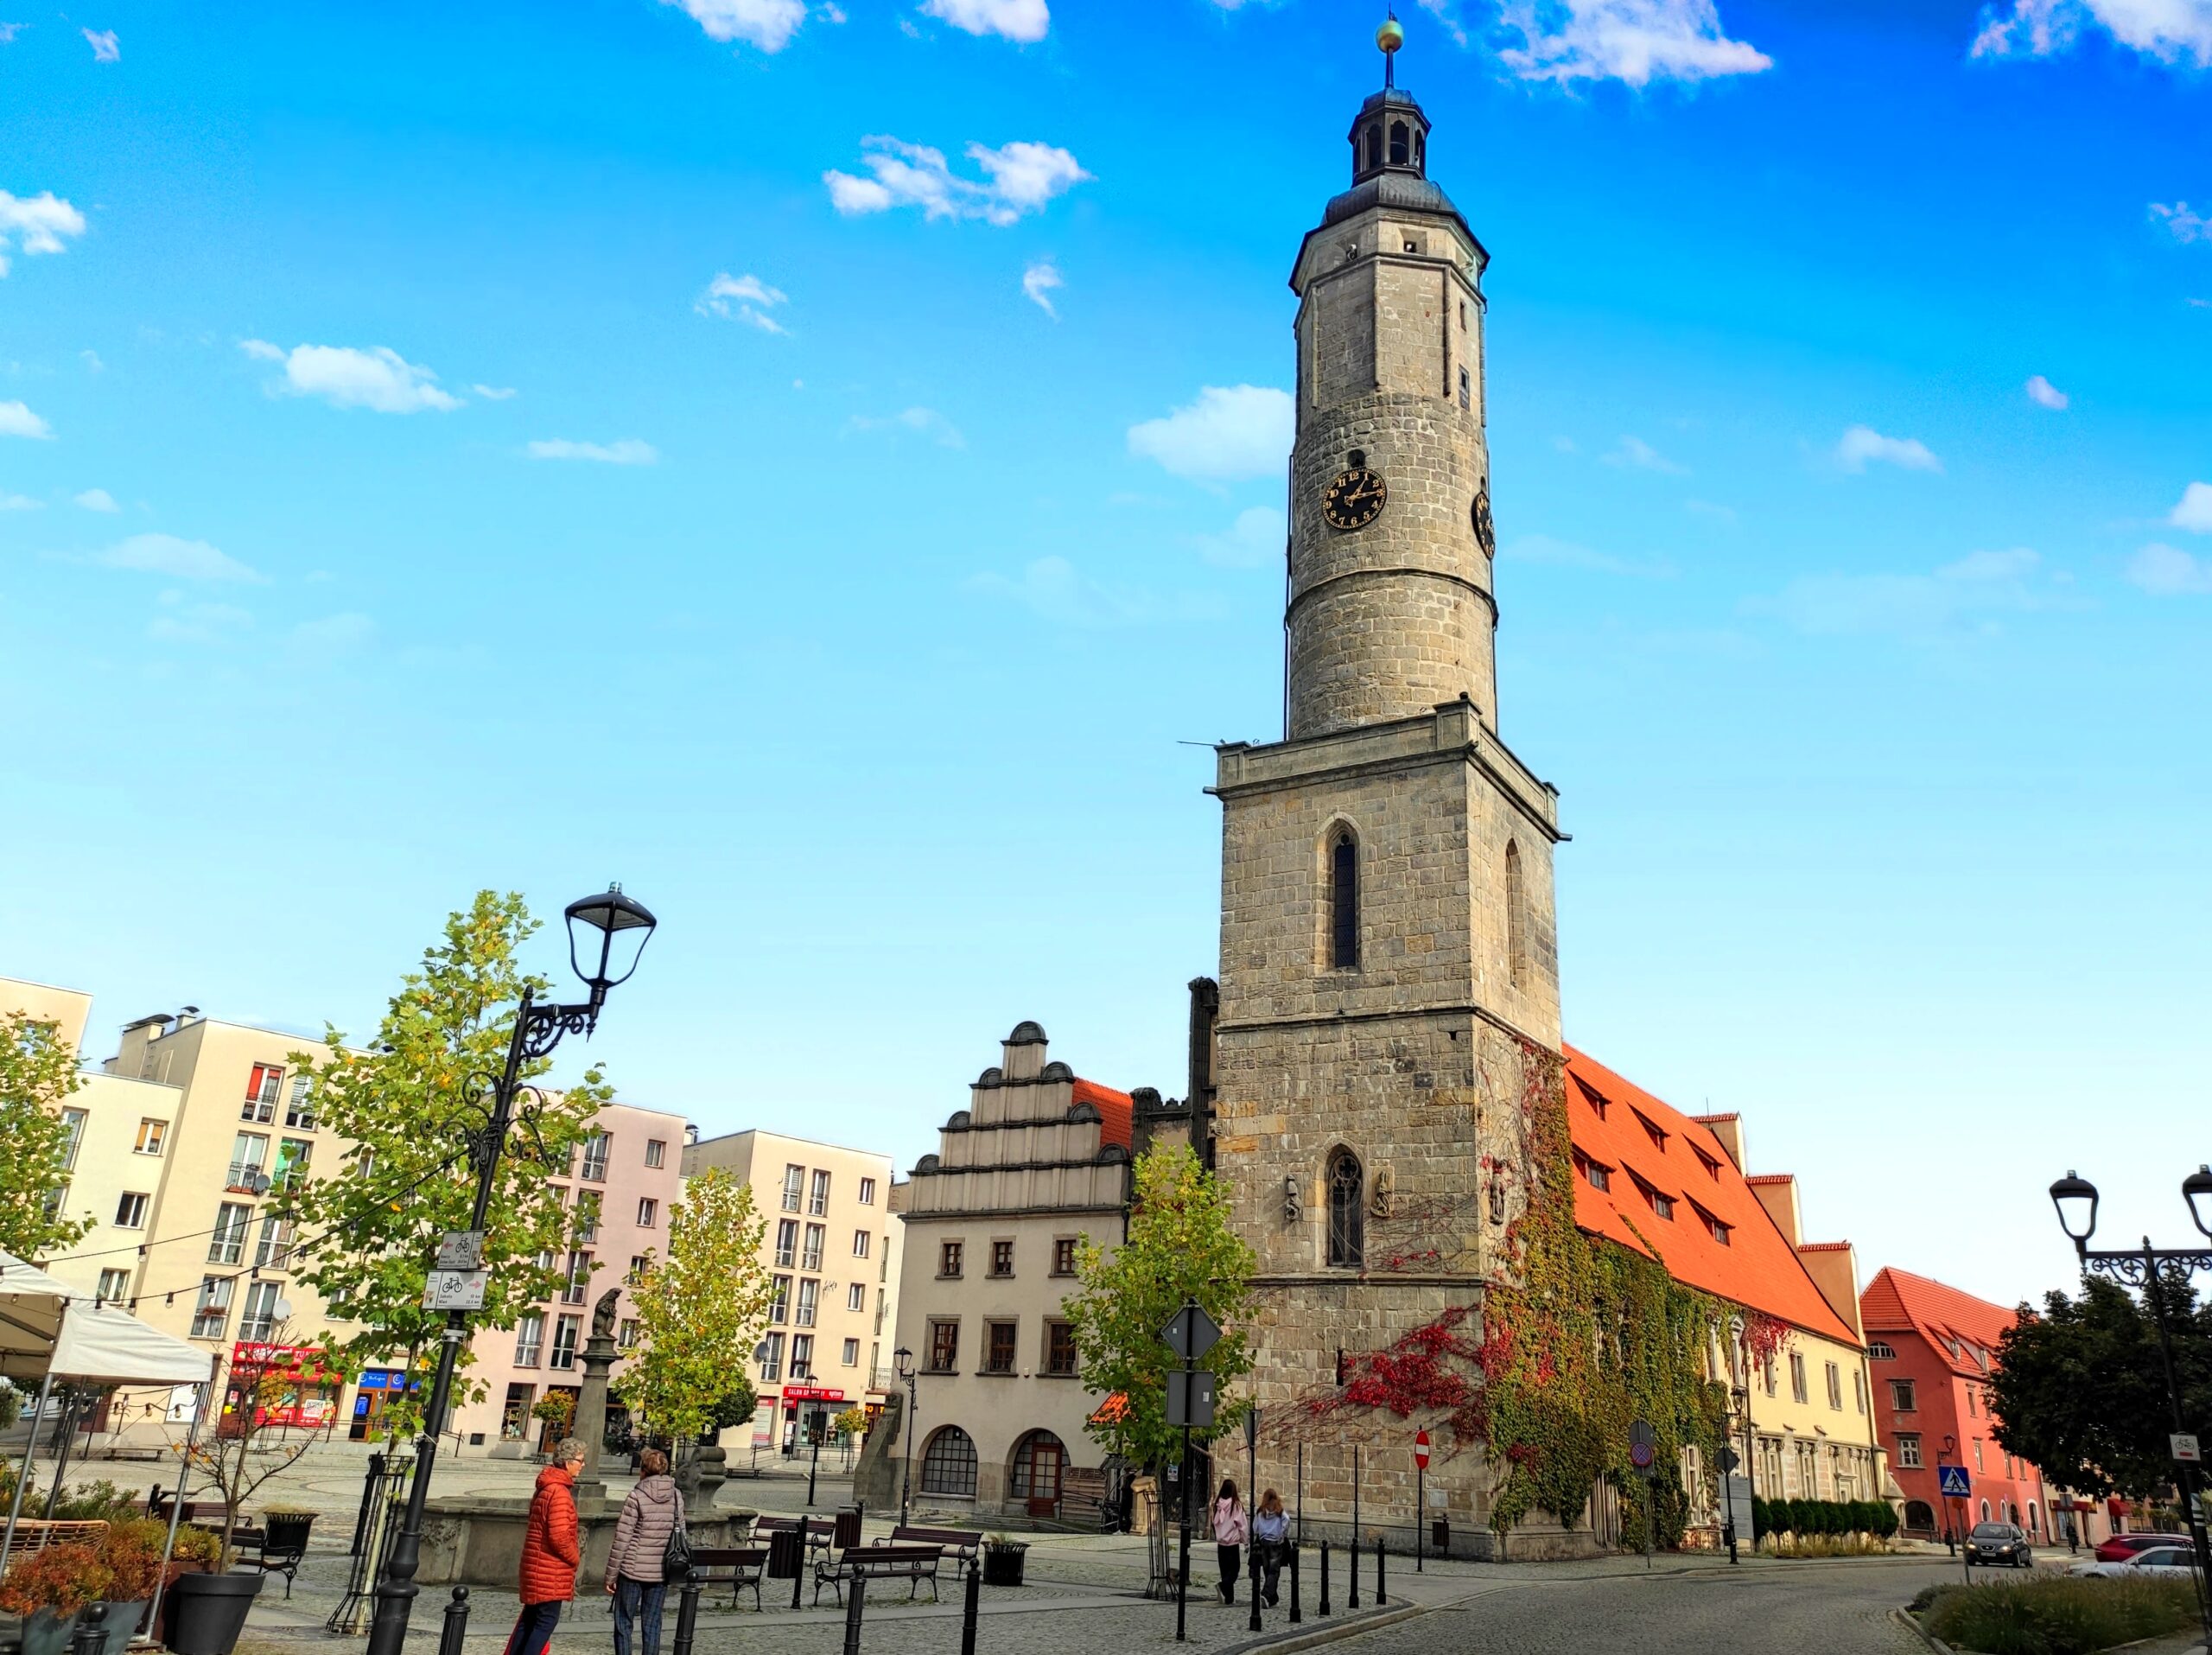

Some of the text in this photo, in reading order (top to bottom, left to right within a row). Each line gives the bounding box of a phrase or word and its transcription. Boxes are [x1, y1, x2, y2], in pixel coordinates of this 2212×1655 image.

[1349, 472, 1359, 481] 12
[1338, 478, 1346, 487] 11
[1372, 480, 1379, 488] 2
[1329, 488, 1339, 499] 10
[1371, 500, 1378, 509] 4
[1363, 511, 1370, 520] 5
[1338, 516, 1345, 525] 7
